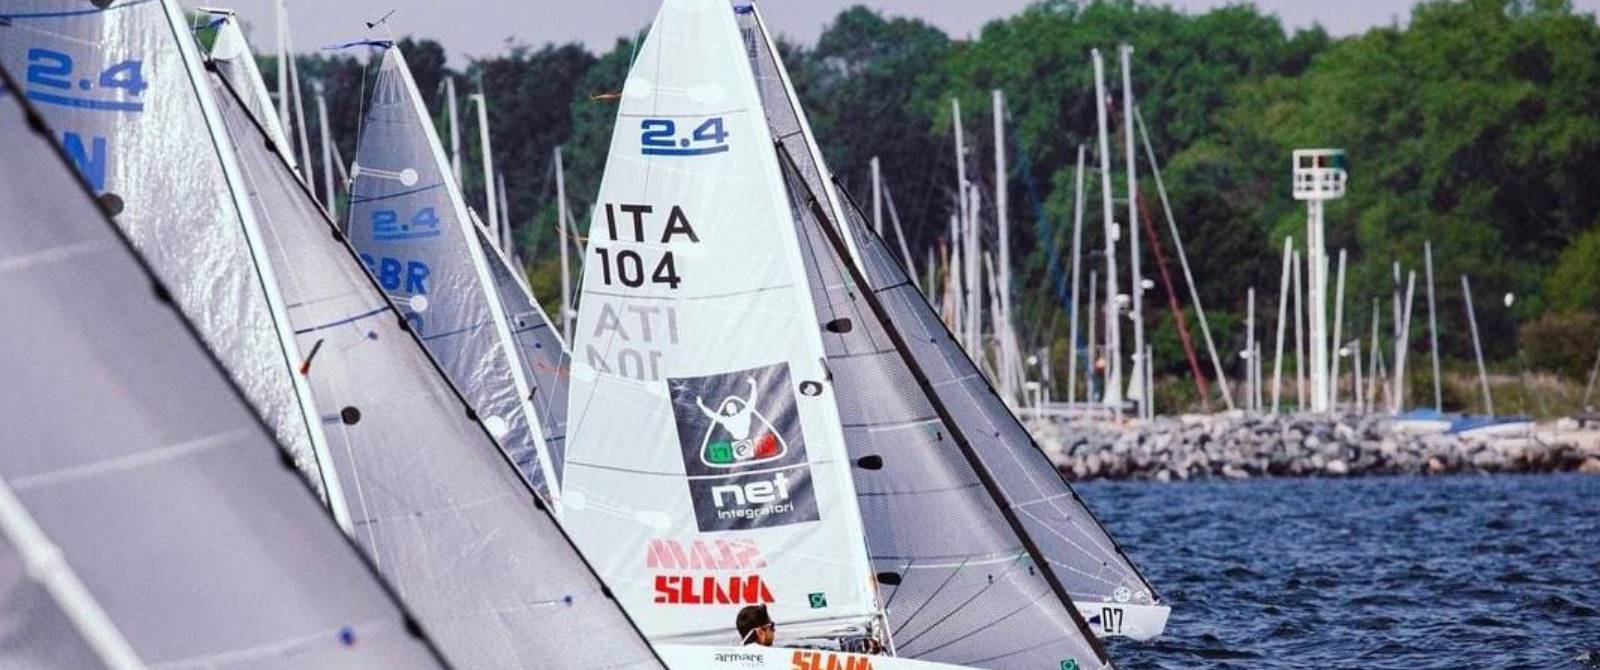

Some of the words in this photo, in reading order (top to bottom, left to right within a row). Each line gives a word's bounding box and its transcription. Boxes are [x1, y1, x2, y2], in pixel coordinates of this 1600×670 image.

[27, 48, 148, 97] 2.4
[641, 117, 729, 148] 2.4
[372, 207, 440, 233] 2.4
[604, 203, 700, 243] ITA
[595, 247, 681, 289] 104
[711, 472, 789, 508] net
[718, 502, 794, 520] integratori
[654, 575, 775, 604] SLAM
[1102, 607, 1123, 634] 07
